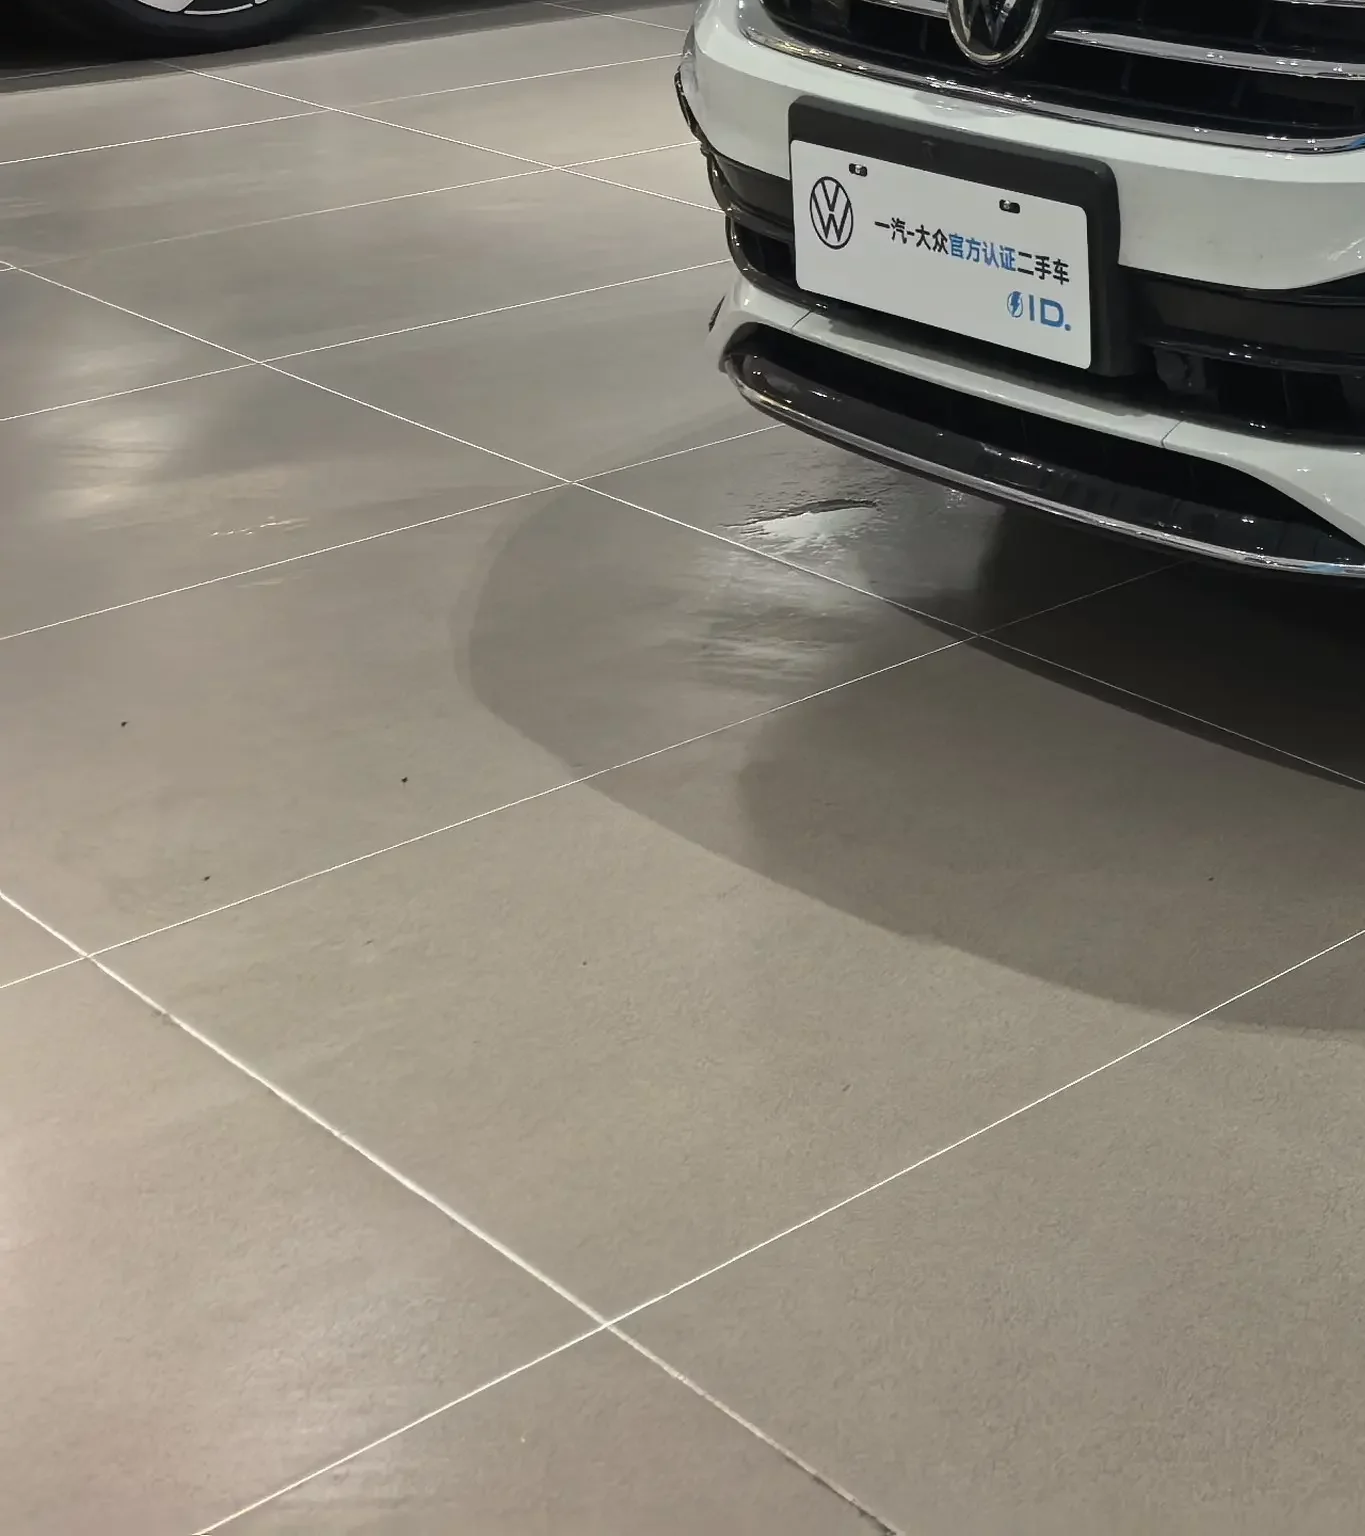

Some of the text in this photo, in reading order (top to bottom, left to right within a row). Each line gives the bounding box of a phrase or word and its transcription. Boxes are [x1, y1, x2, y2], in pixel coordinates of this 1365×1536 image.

[874, 216, 1071, 286] 一汽-大众官方认证二手车
